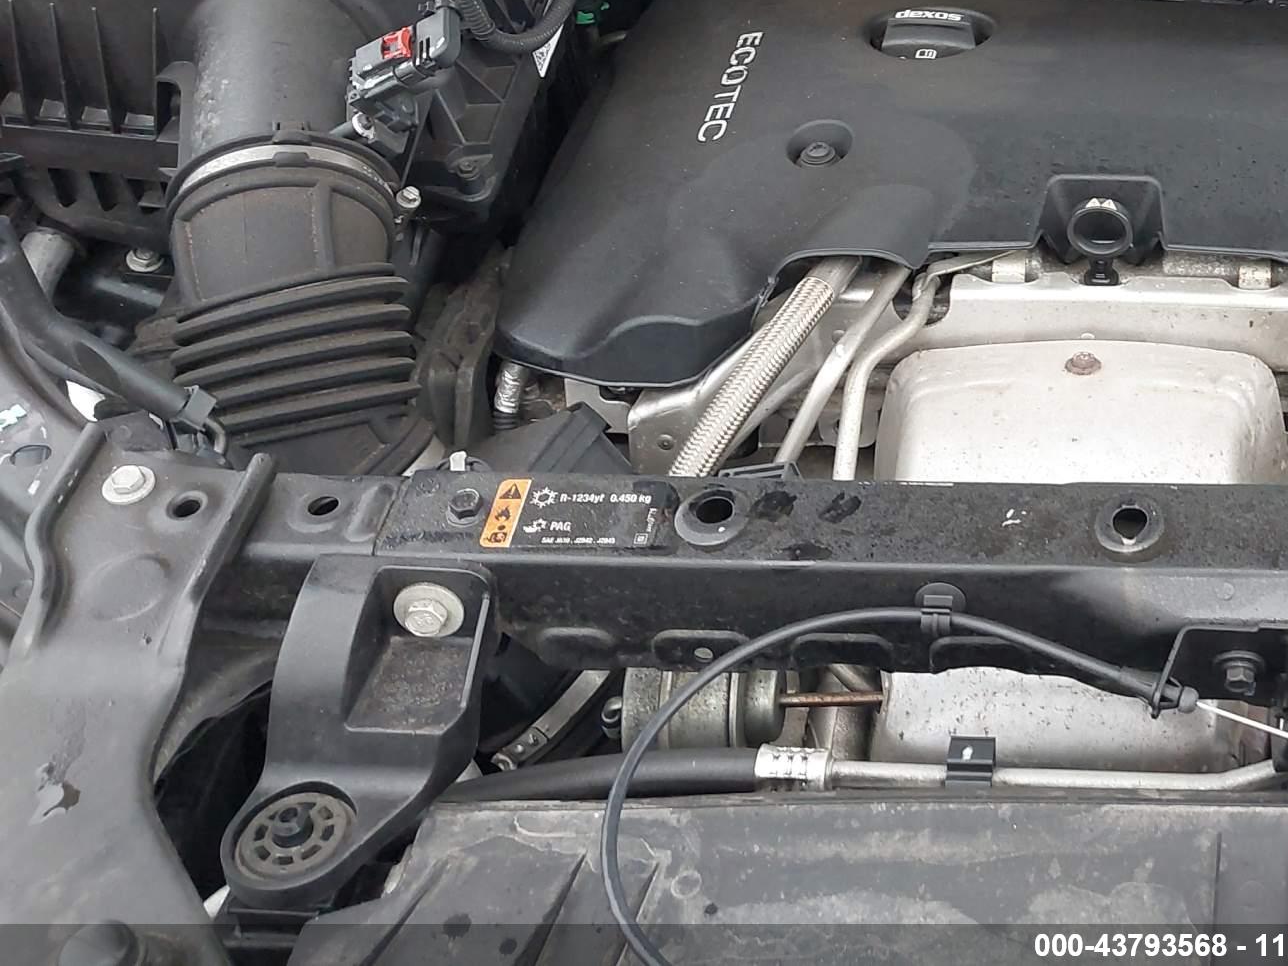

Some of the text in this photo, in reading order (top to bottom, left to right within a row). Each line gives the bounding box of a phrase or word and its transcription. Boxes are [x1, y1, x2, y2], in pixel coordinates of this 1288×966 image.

[895, 9, 965, 22] dexos
[697, 31, 764, 142] ECOTEC
[560, 493, 652, 505] R-1234yf 0.450 kg
[550, 521, 571, 531] PAG
